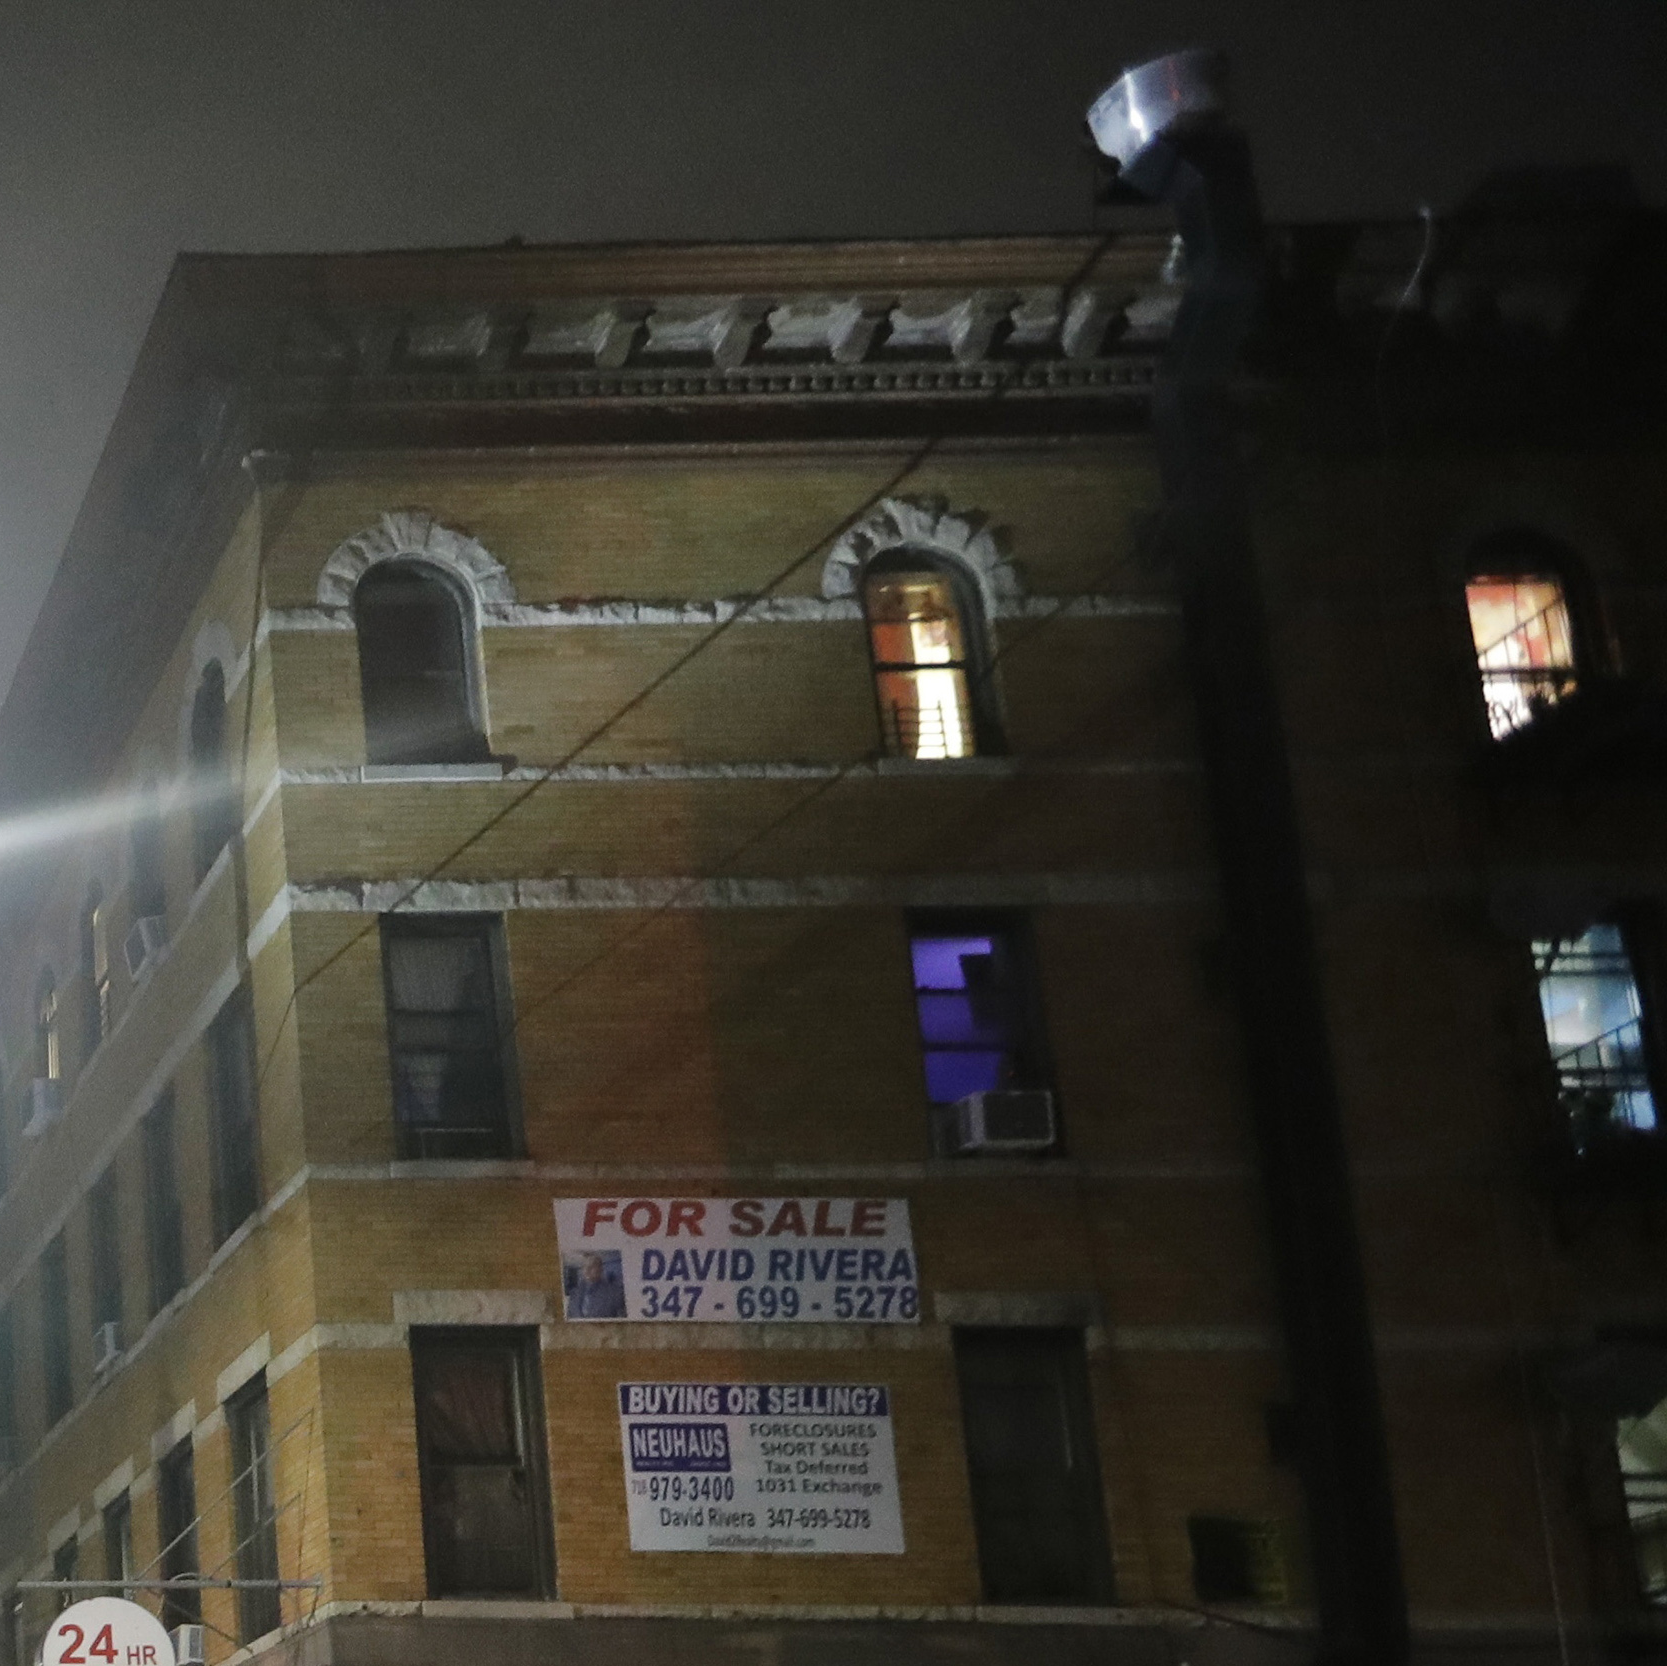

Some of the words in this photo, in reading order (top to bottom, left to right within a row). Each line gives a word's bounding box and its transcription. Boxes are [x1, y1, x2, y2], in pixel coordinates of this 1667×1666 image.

[582, 1200, 707, 1238] FOR
[728, 1200, 888, 1238] SALE
[641, 1248, 755, 1282] DAVID
[768, 1248, 914, 1282] RIVERA
[640, 1286, 703, 1318] 347
[736, 1286, 800, 1318] 699
[833, 1286, 919, 1319] 5278
[628, 1385, 720, 1414] BUYING
[727, 1386, 761, 1414] OR
[767, 1386, 881, 1415] SELLING?
[632, 1427, 727, 1459] NEUHAUS
[749, 1422, 878, 1438] FORECLOSURES
[759, 1441, 817, 1457] SHORT
[821, 1442, 870, 1457] SALES
[766, 1459, 792, 1474] Tax
[796, 1459, 869, 1475] Deferred
[649, 1475, 735, 1501] 979-3400
[755, 1478, 797, 1493] 1031
[802, 1478, 884, 1498] Exchange
[659, 1506, 704, 1527] David
[707, 1506, 757, 1528] Rivera
[58, 1623, 119, 1664] 24
[127, 1645, 158, 1666] HR
